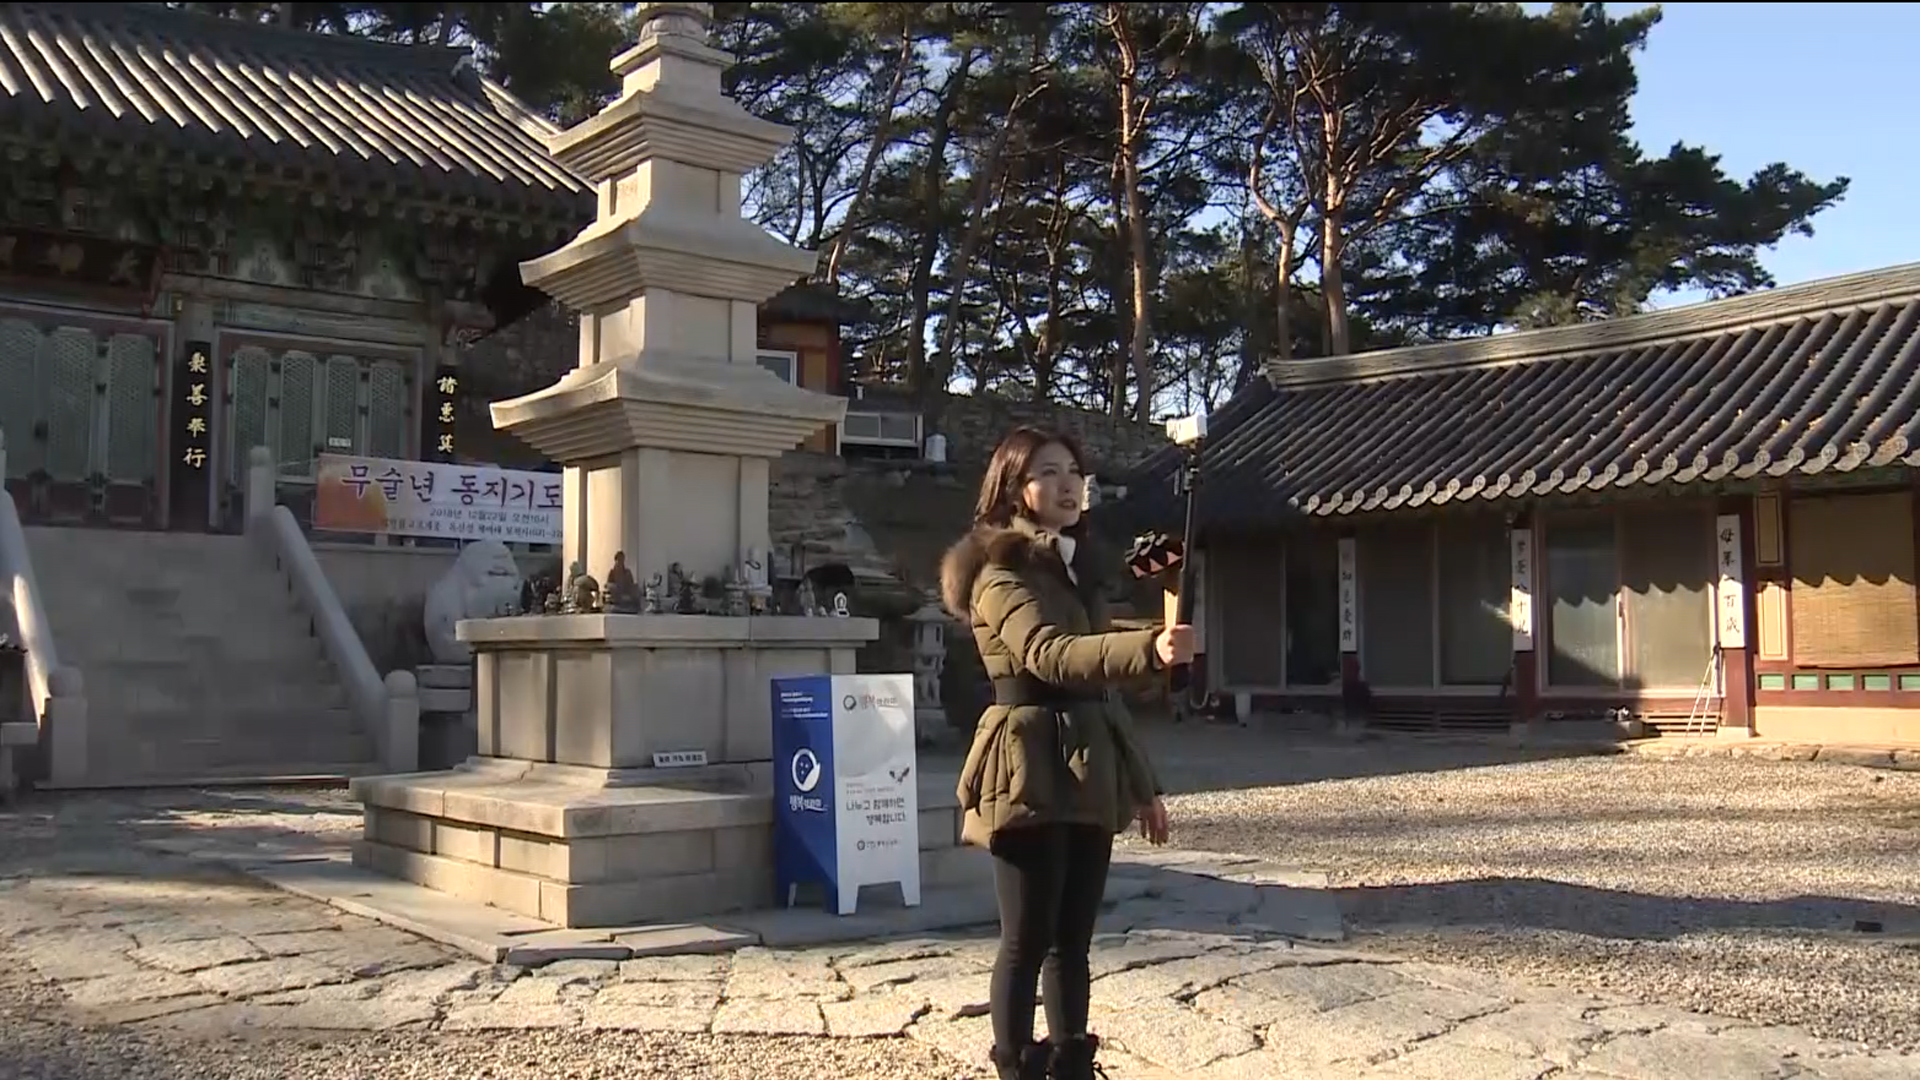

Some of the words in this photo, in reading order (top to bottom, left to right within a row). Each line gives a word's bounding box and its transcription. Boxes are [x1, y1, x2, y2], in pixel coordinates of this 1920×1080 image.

[342, 465, 434, 503] 무술년
[451, 473, 563, 510] 동지기도
[430, 507, 462, 519] 2018년
[846, 801, 871, 812] 나누고
